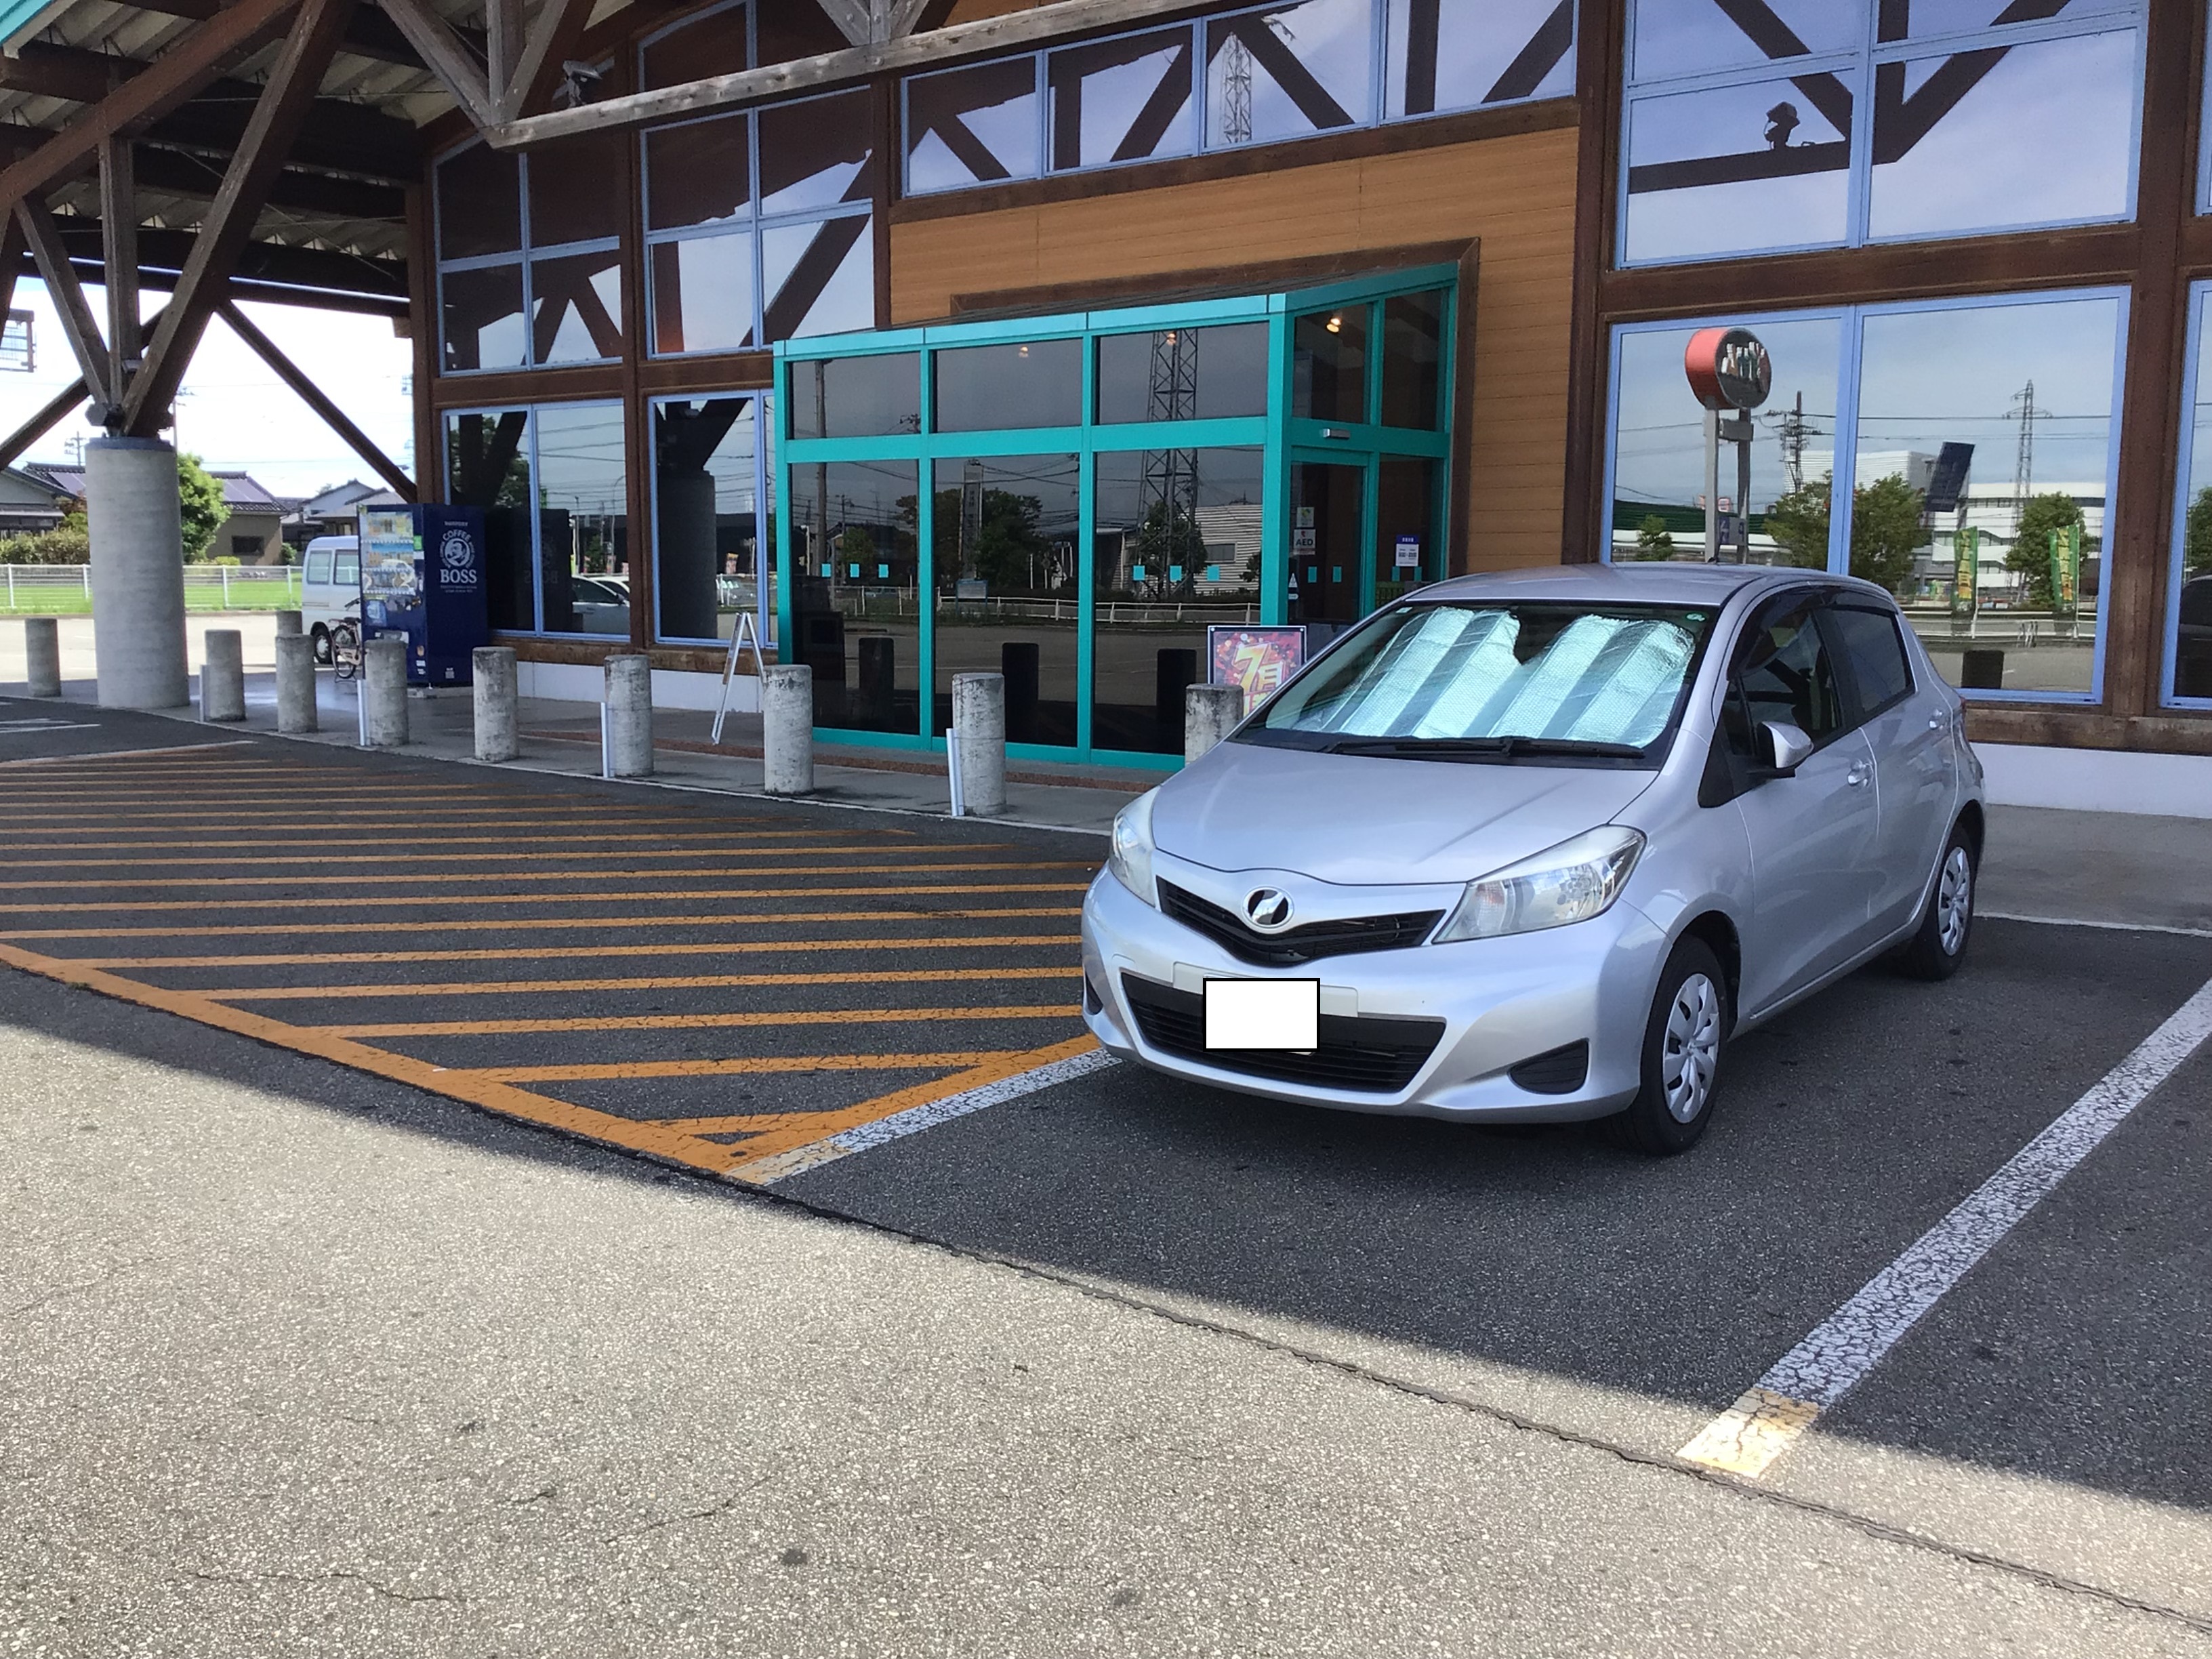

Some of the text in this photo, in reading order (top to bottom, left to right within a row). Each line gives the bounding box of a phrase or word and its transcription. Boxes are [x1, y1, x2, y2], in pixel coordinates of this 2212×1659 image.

[443, 529, 471, 541] COFFEE
[1295, 538, 1313, 546] AED
[440, 569, 477, 583] BOSS
